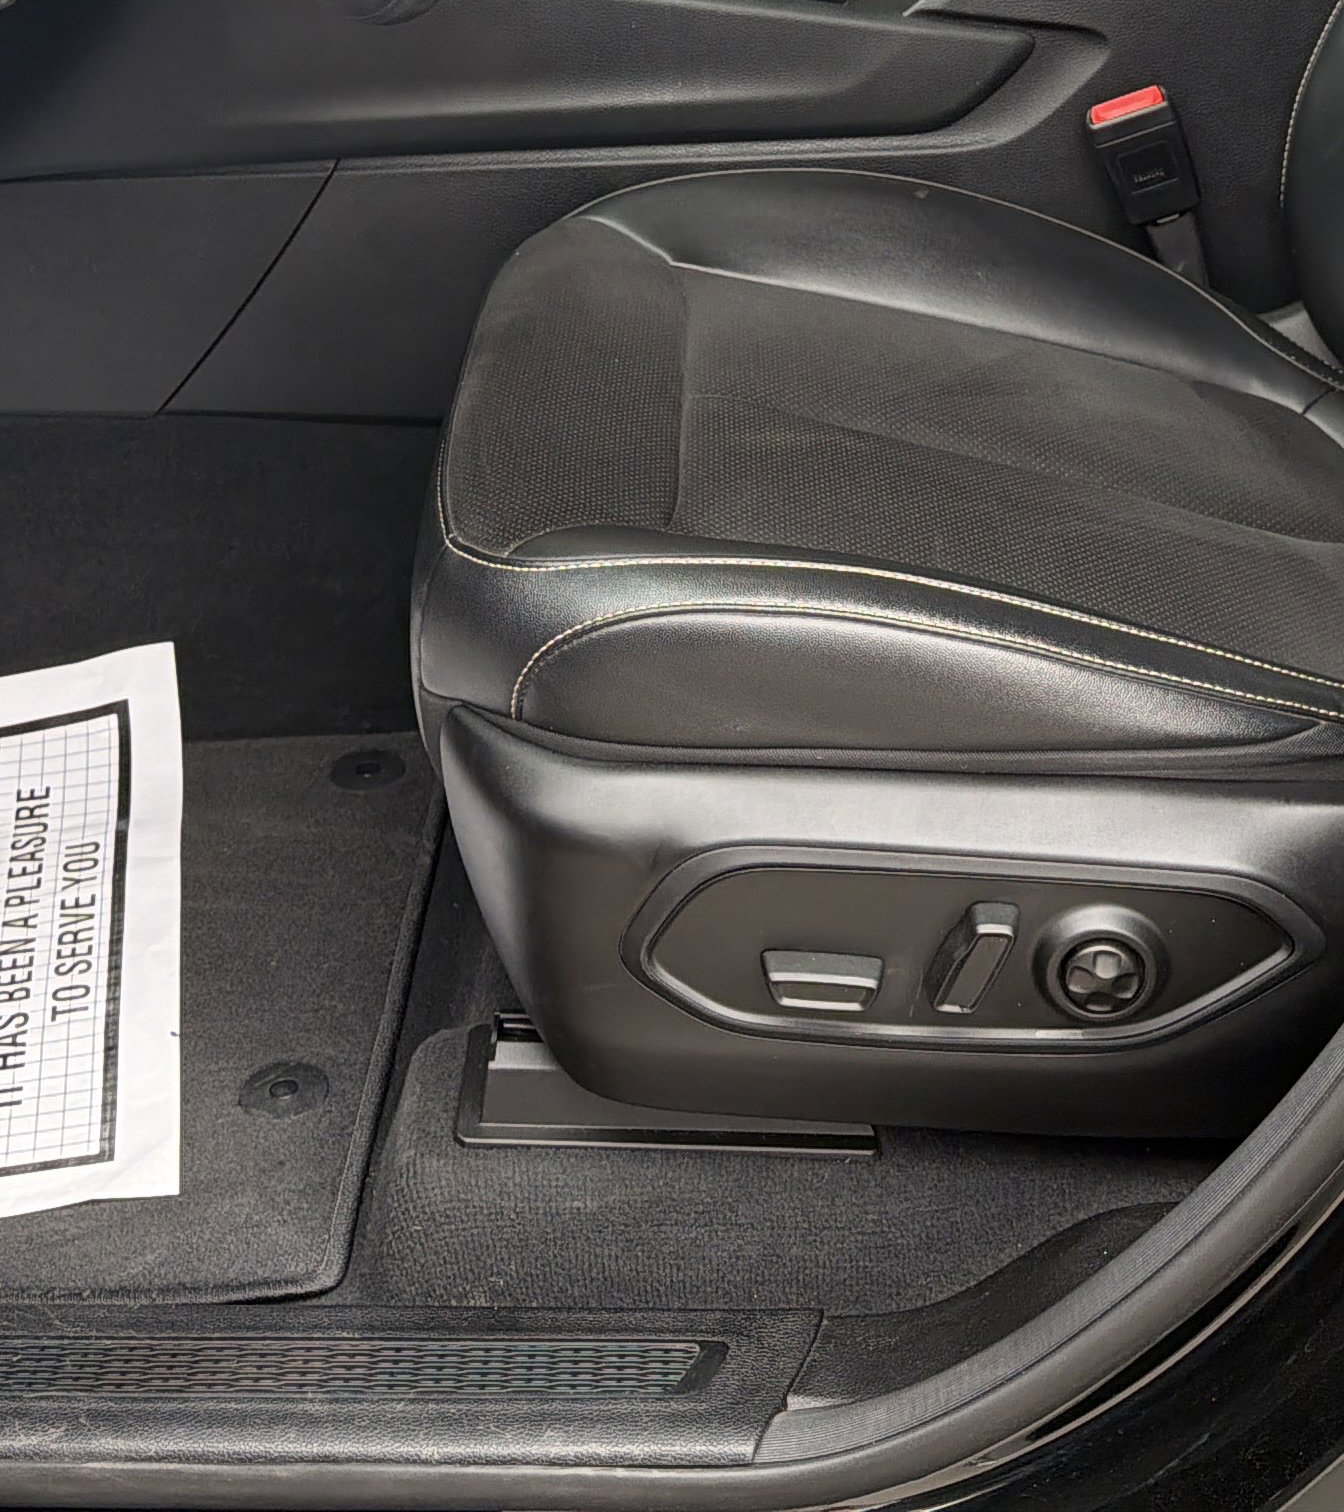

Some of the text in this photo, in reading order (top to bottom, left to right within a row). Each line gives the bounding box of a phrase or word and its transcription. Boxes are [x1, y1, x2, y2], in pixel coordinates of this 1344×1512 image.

[4, 786, 50, 908] PLEASURE
[1, 913, 39, 929] A
[51, 841, 101, 1022] TO SERVE YOU
